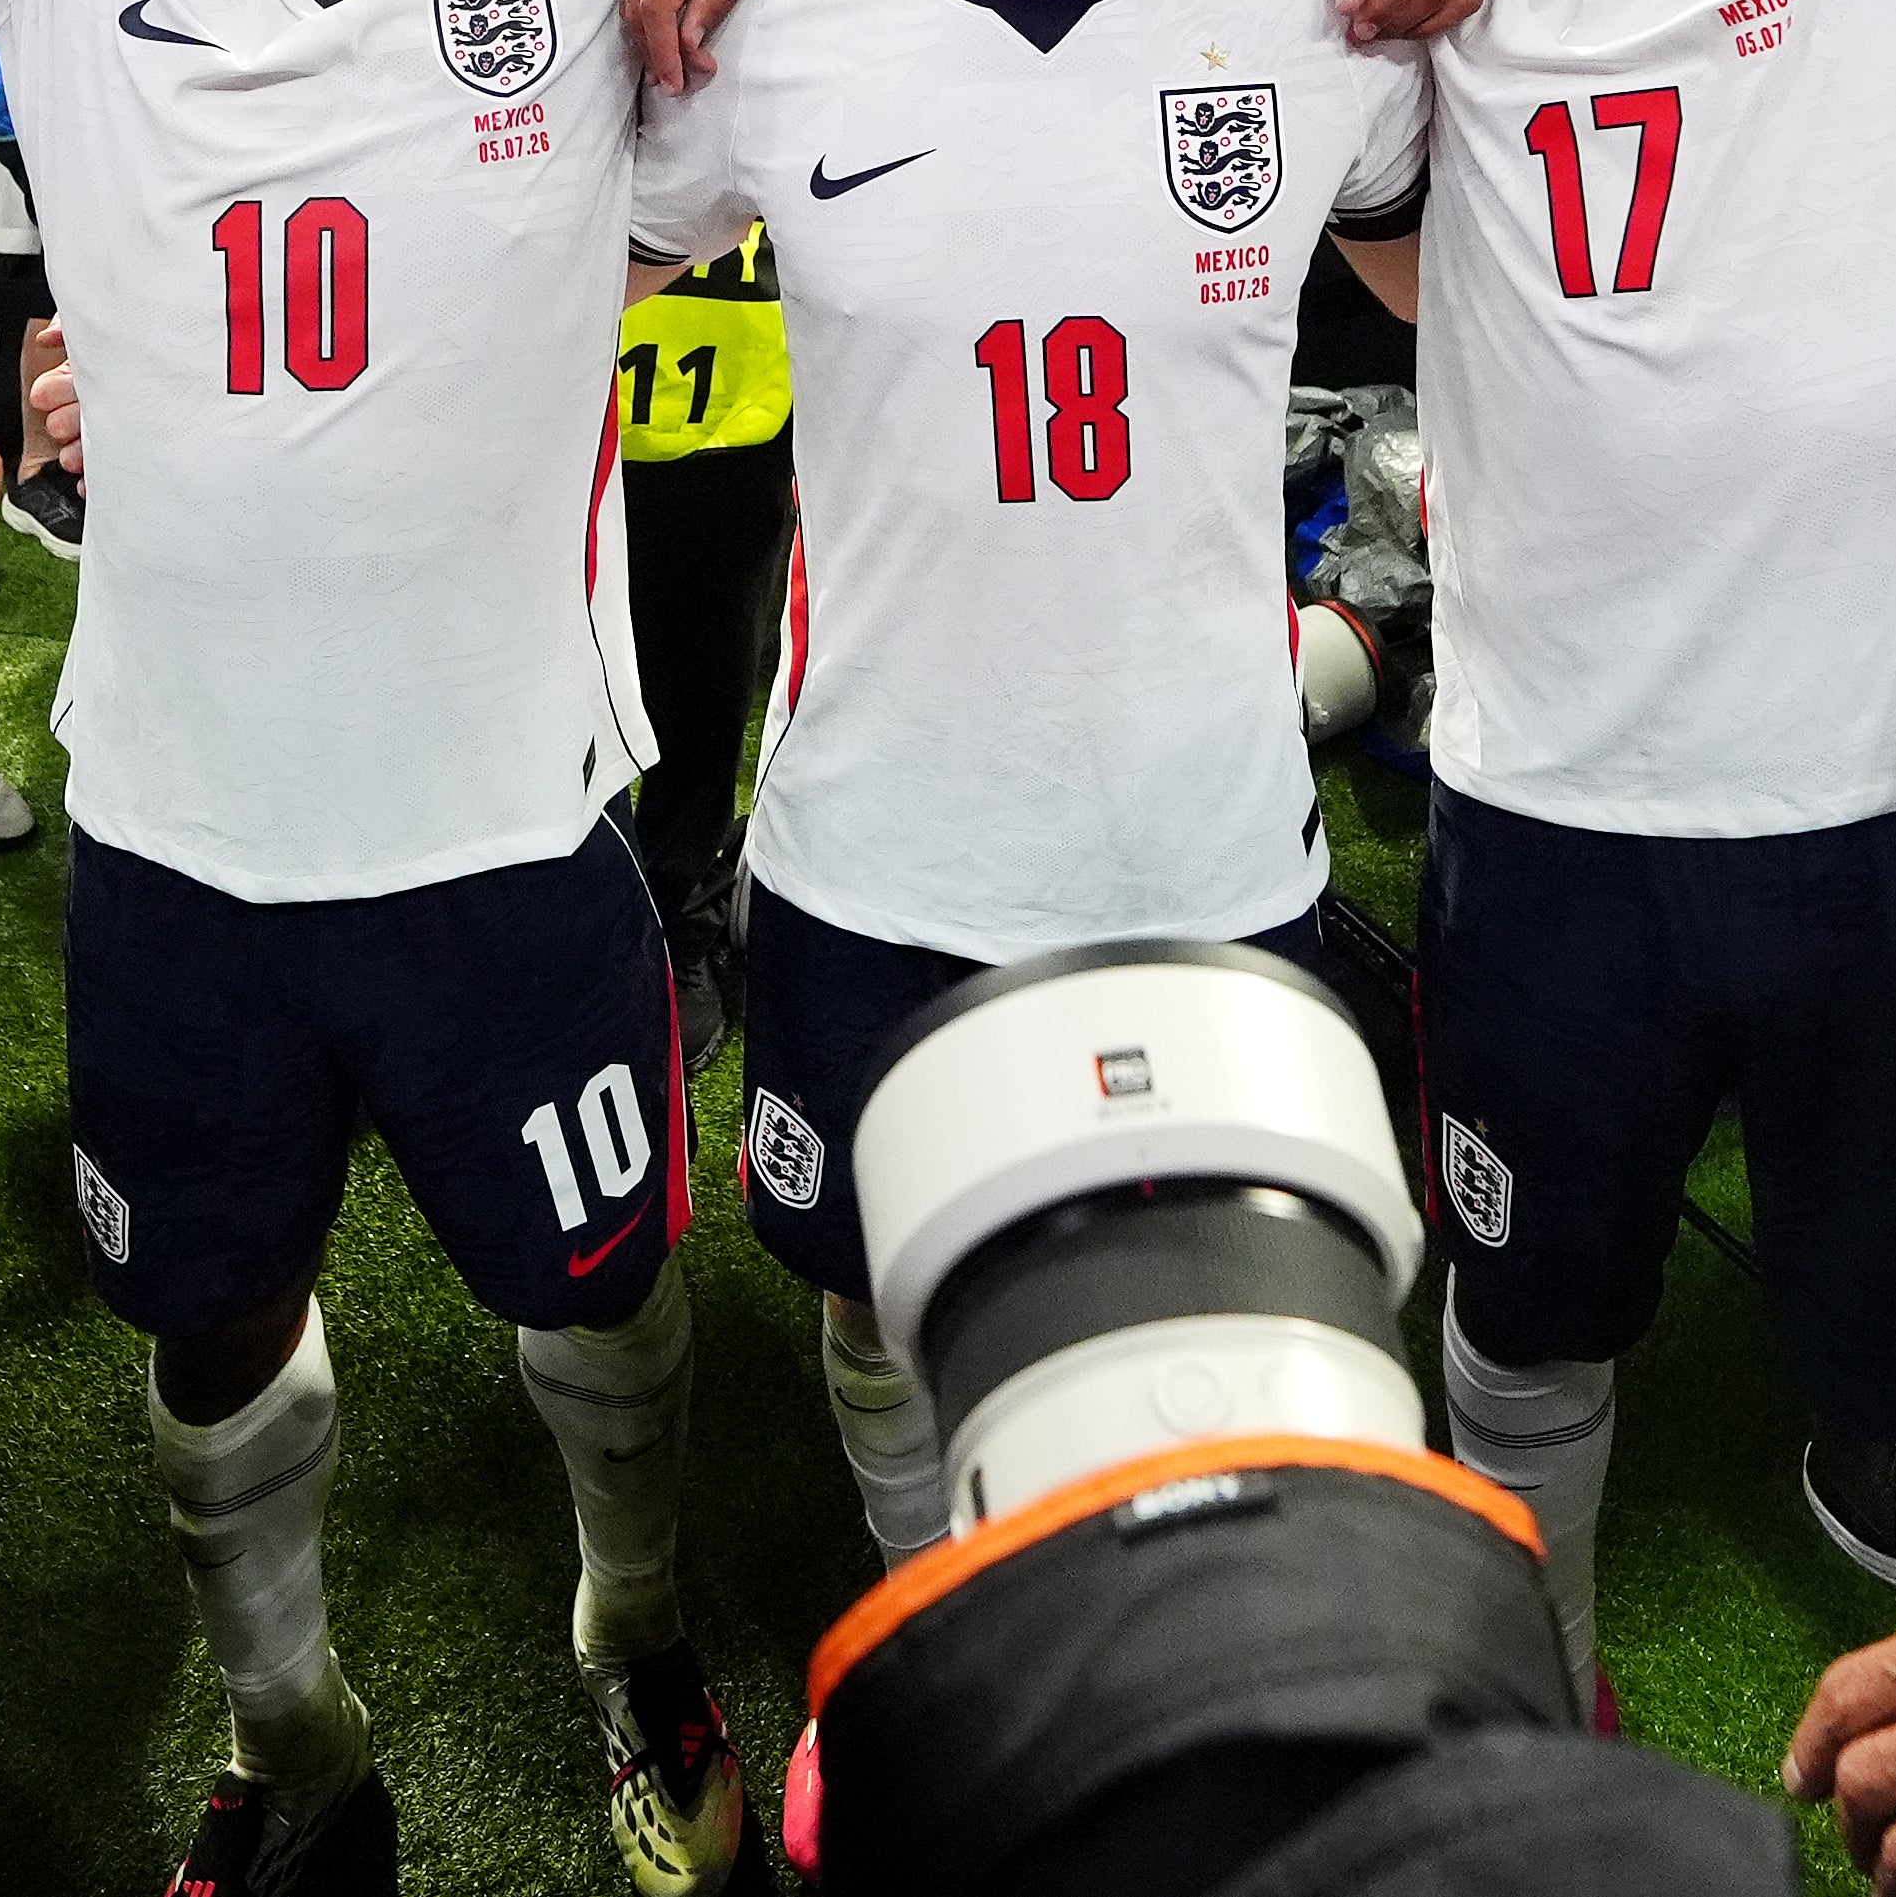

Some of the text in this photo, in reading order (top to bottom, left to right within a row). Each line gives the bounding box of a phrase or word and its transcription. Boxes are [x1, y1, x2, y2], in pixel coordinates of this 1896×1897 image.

[473, 104, 545, 135] MEXICO
[478, 132, 551, 164] 05.07.26
[1524, 85, 1683, 299] 17
[212, 197, 369, 396] 10
[1195, 244, 1271, 276] MEXICO
[1199, 276, 1271, 307] 05.07.26
[975, 315, 1132, 504] 18
[520, 1062, 652, 1234] 10
